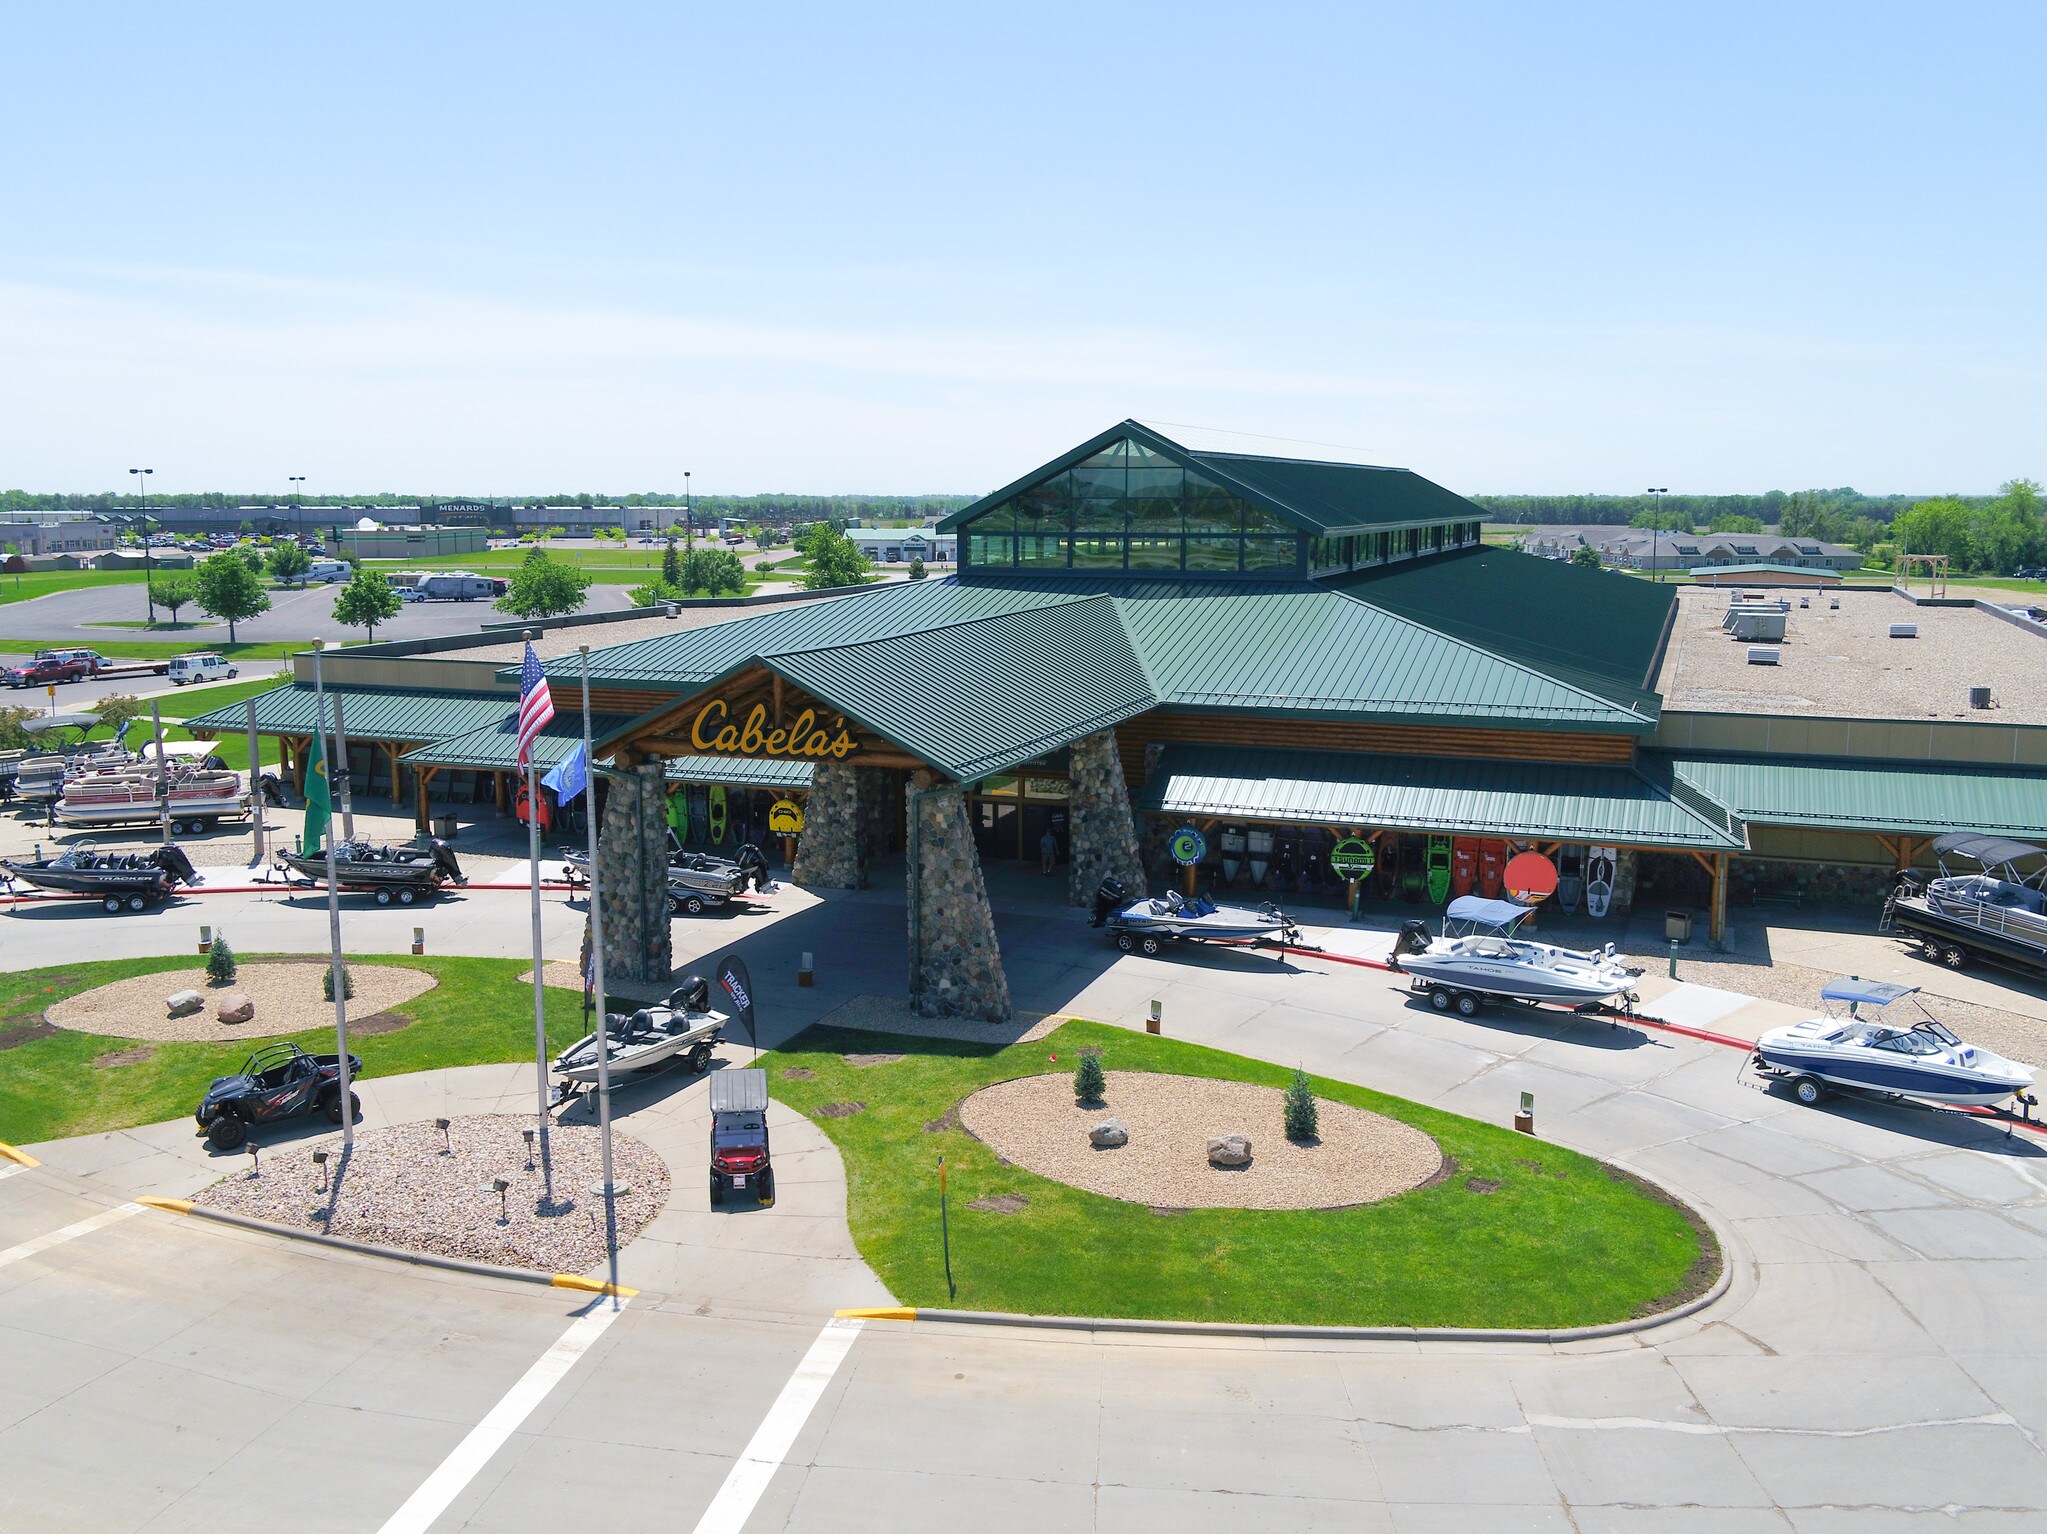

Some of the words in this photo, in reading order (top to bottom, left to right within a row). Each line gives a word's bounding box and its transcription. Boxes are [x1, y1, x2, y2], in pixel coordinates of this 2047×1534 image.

[439, 504, 485, 512] MENARDS
[691, 699, 858, 758] Cabela's
[1184, 841, 1192, 850] 2
[1467, 965, 1502, 974] TAHOE
[724, 970, 751, 1009] TRACKER
[1930, 1108, 1971, 1116] TAHOE
